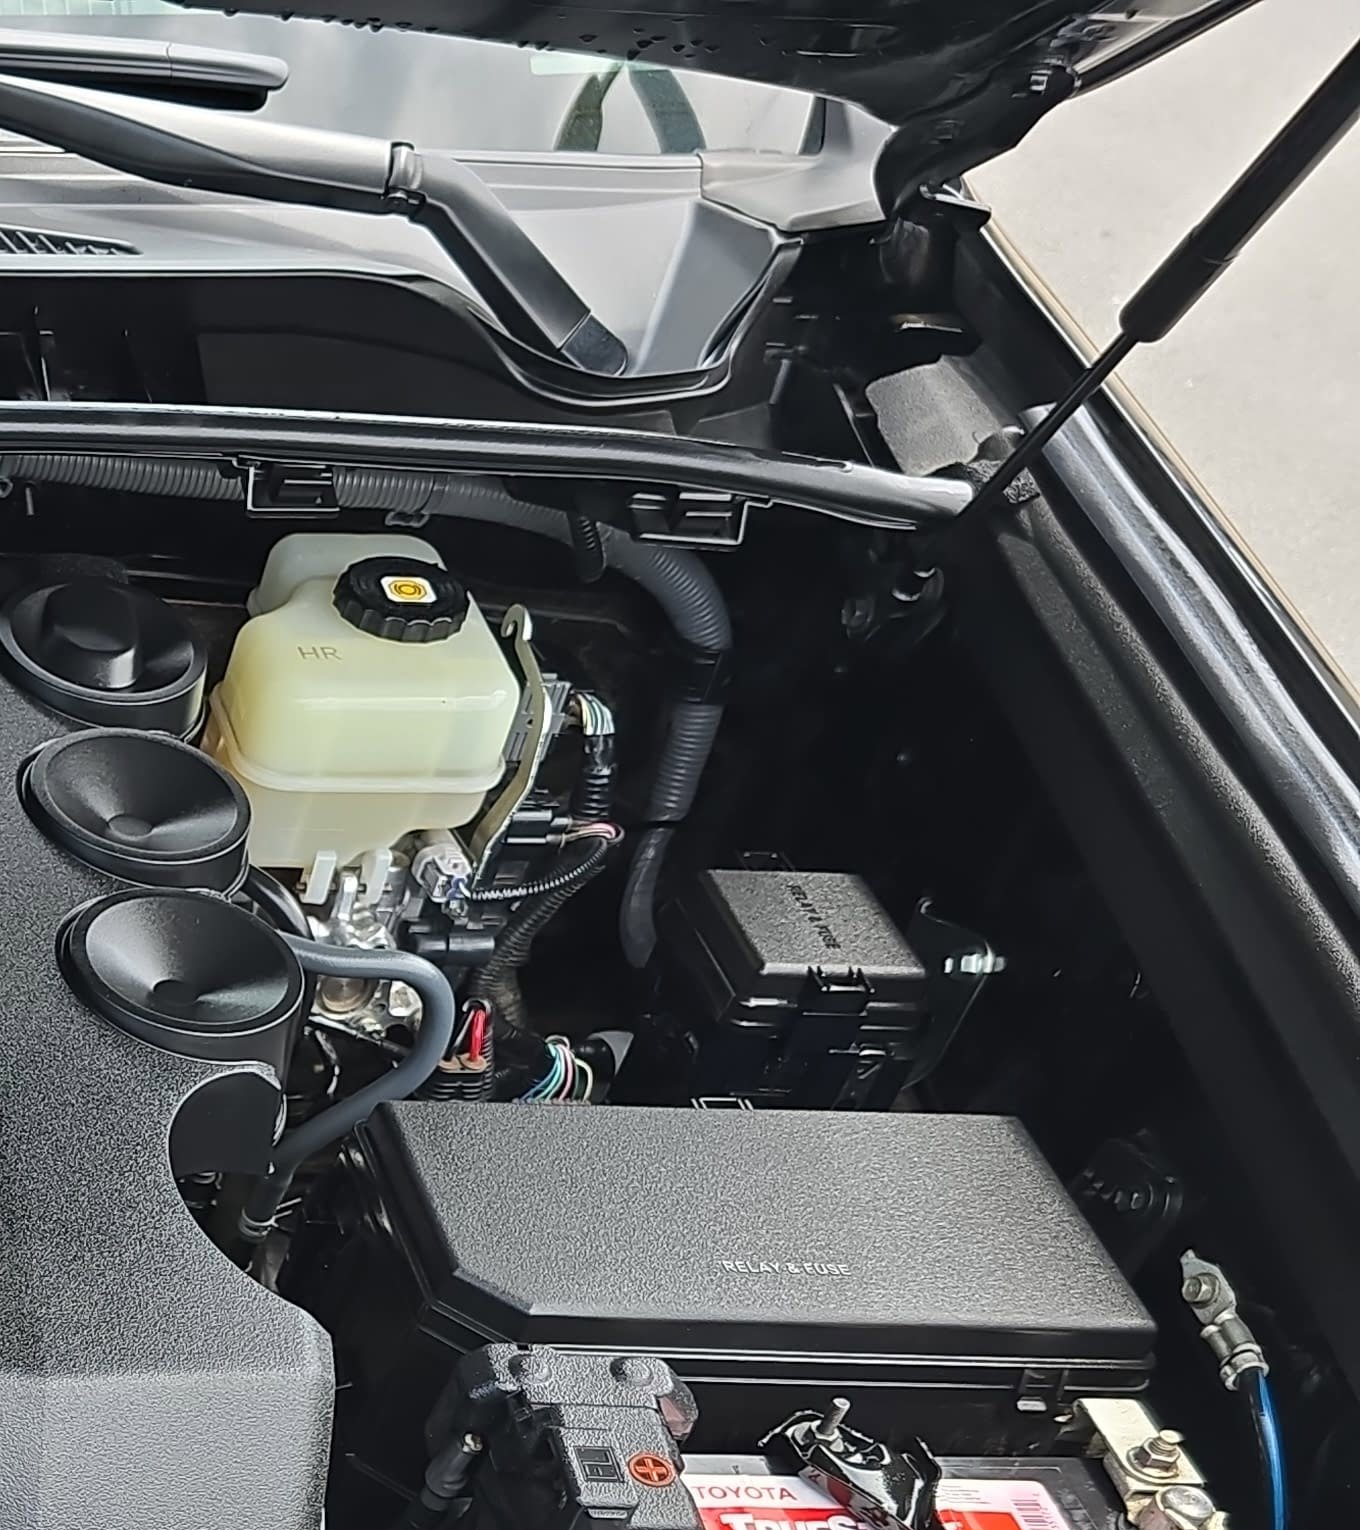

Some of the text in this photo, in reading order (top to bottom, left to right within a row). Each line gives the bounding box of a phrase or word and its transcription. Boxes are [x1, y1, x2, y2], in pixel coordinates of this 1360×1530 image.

[297, 645, 342, 660] HR
[719, 1260, 852, 1277] RELAY & FUSE
[696, 1485, 798, 1501] TOYOTA
